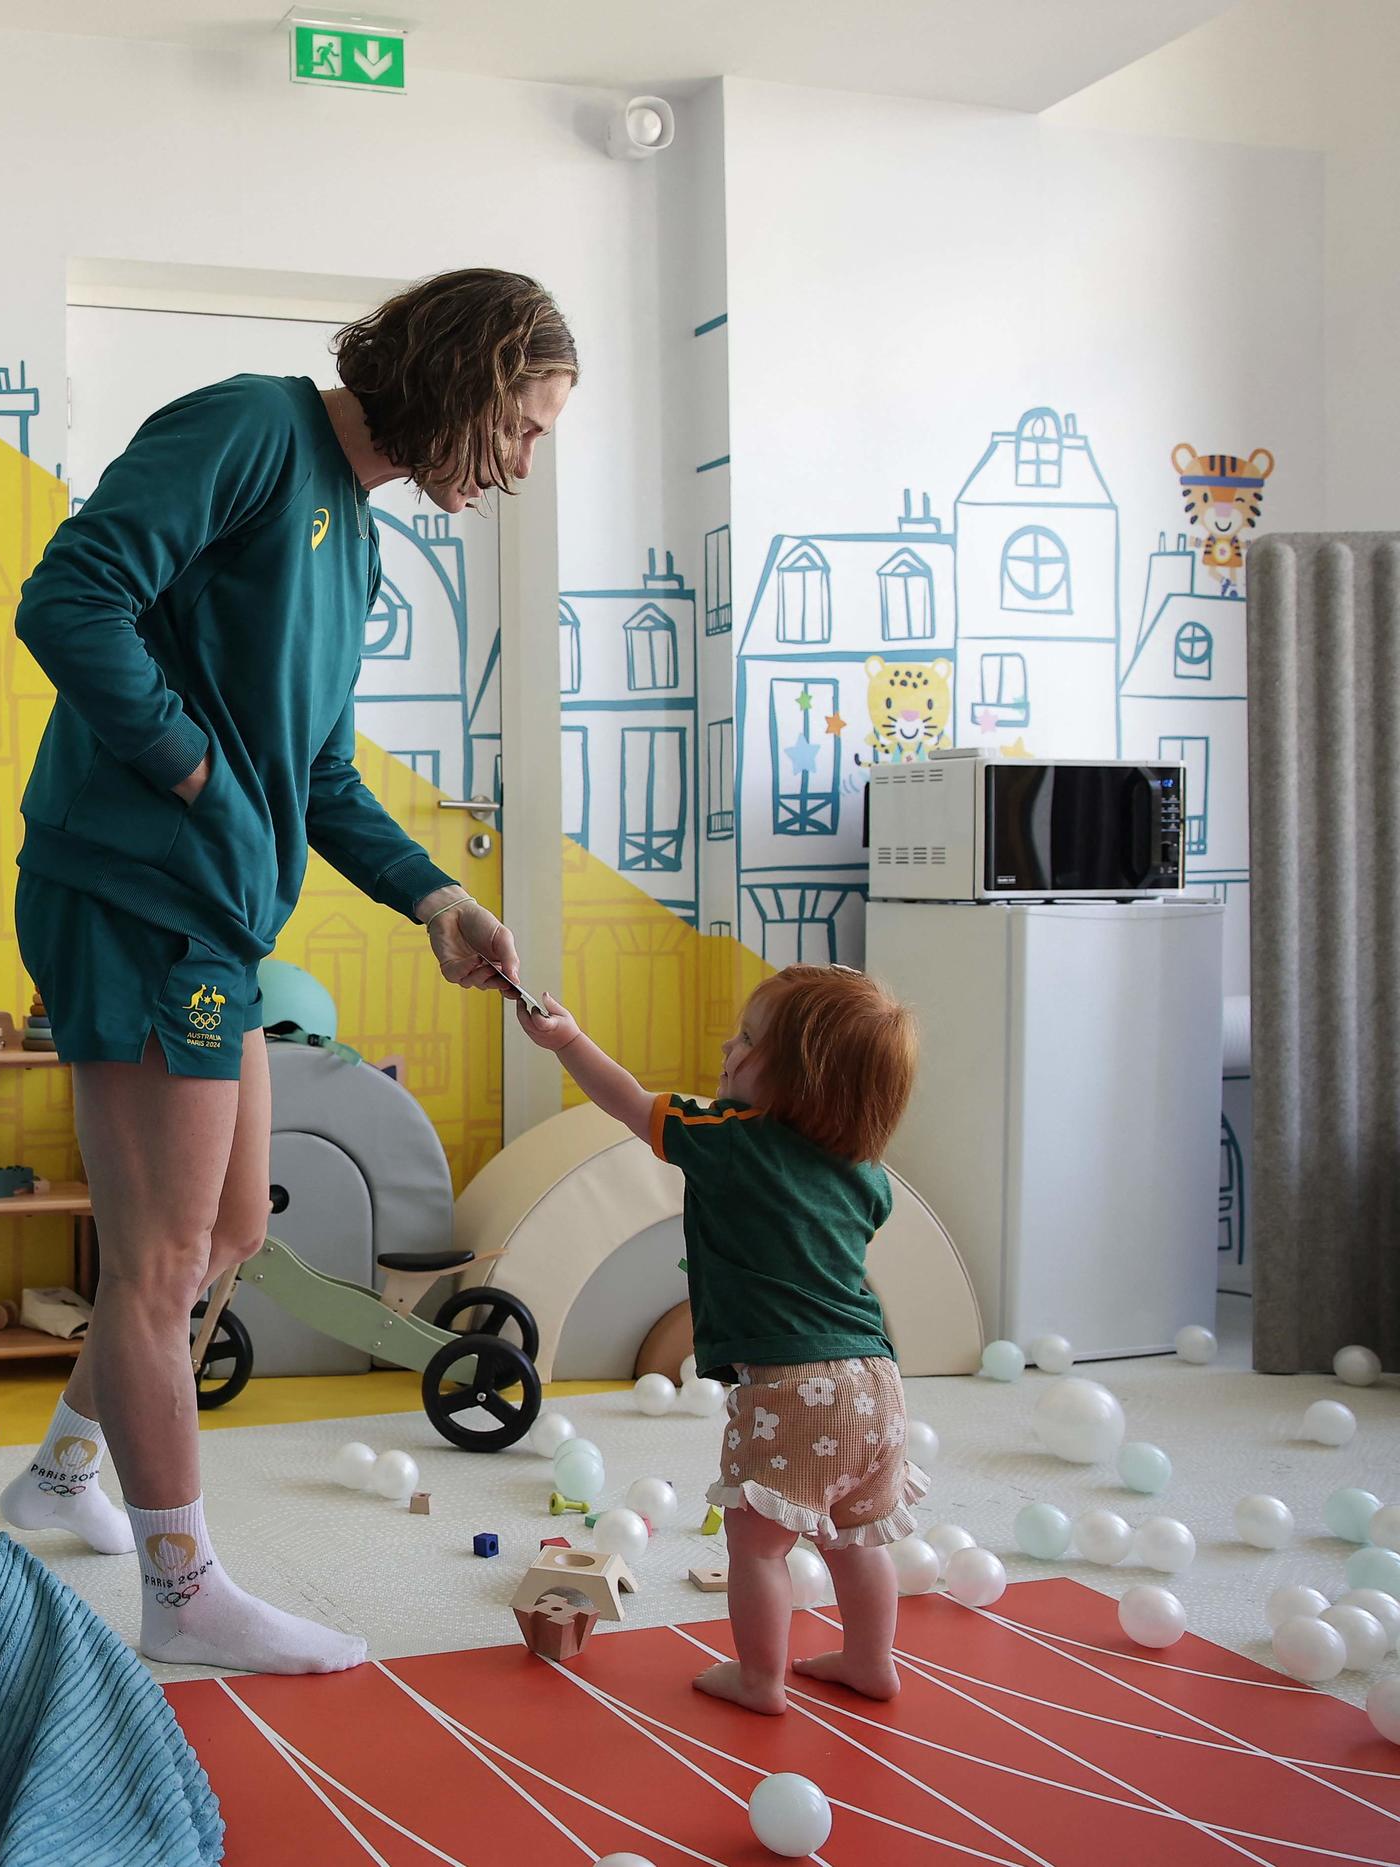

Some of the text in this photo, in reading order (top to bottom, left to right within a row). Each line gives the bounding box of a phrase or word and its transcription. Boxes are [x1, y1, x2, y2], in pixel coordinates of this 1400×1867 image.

[187, 1032, 221, 1041] AUSTRALIA
[31, 1464, 67, 1481] PARIS
[145, 1559, 213, 1588] PARIS 2024
